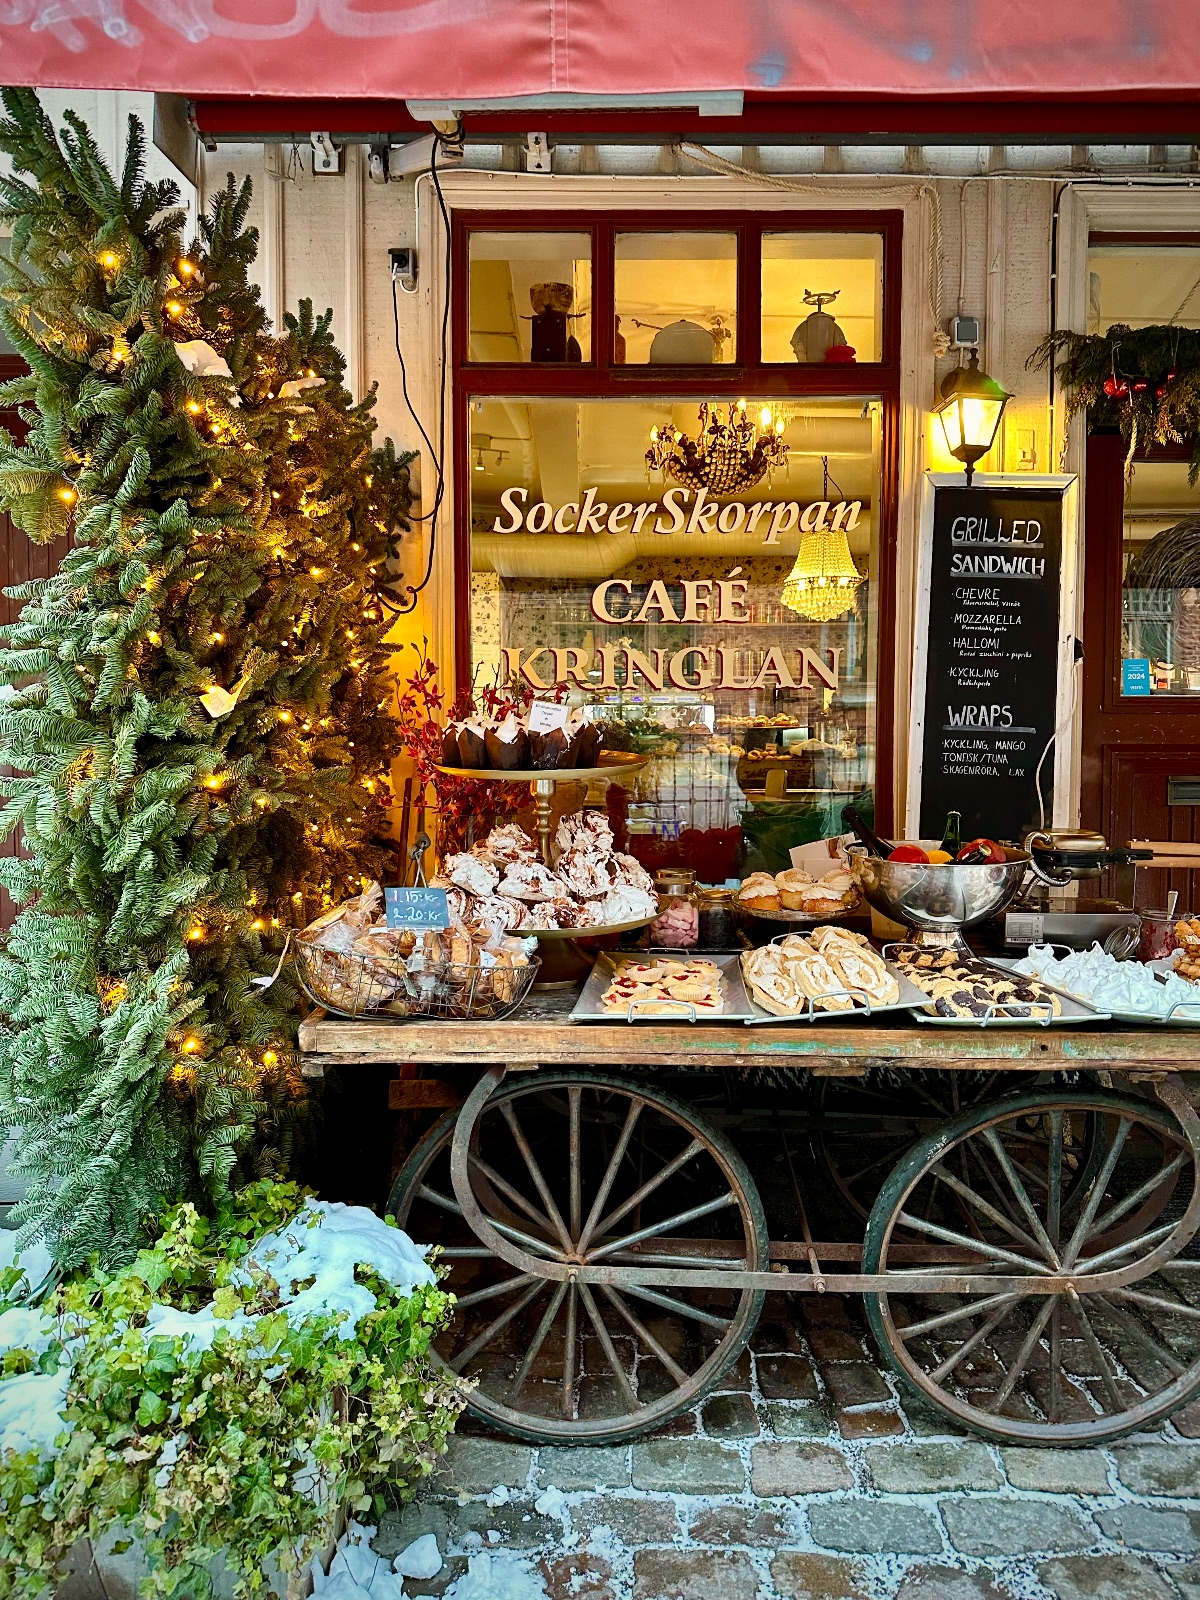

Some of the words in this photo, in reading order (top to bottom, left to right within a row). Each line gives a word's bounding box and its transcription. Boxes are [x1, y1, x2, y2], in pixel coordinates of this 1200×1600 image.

[493, 486, 862, 545] SockerSkorpan
[951, 516, 1042, 543] GRILLED
[950, 553, 1045, 576] SANDWICH
[590, 566, 751, 624] CAFÉ
[955, 587, 1001, 600] CHEVRE
[953, 613, 1022, 625] MOZZARELLA
[952, 637, 1000, 649] HALLOMI
[501, 645, 844, 691] KRINGLAN
[949, 666, 1000, 678] KYCKLING
[947, 704, 1013, 728] WRAPS
[995, 740, 1026, 751] MANGO
[1008, 768, 1025, 777] LAX
